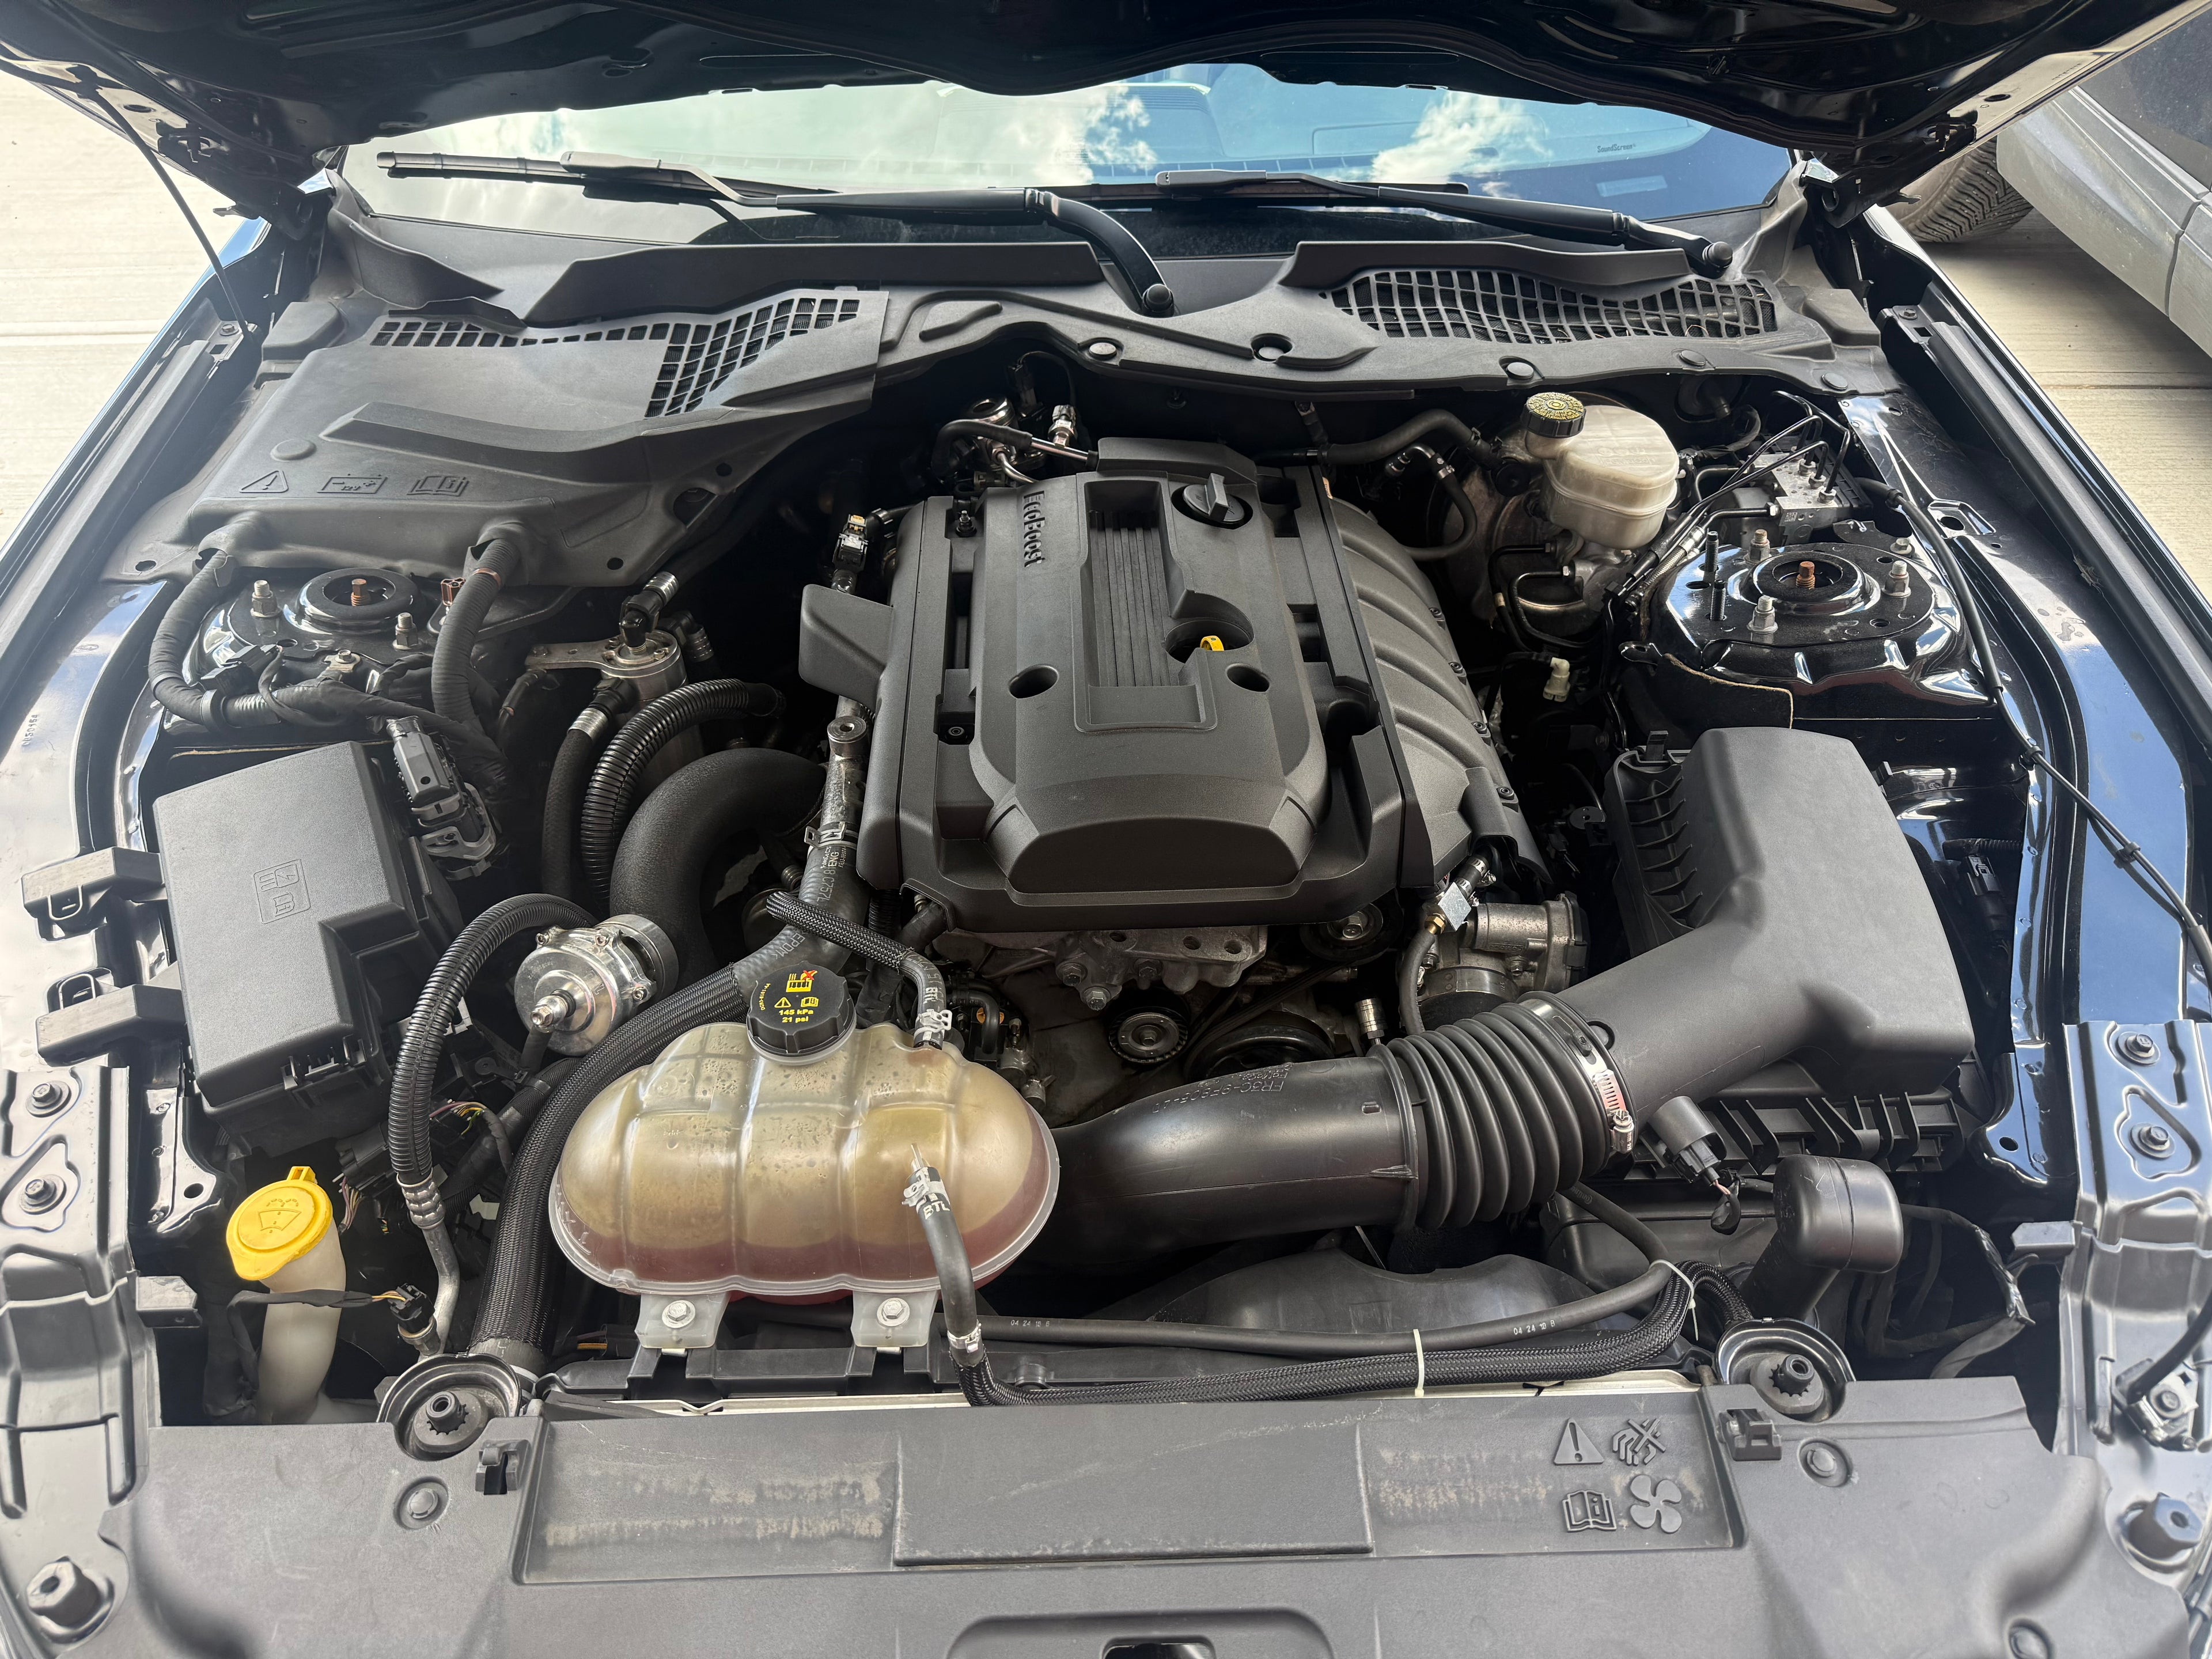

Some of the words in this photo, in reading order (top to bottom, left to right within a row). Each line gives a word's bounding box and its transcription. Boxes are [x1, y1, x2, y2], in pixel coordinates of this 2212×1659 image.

[1597, 143, 1633, 153] SoundScreen
[1023, 490, 1046, 567] EcoBoost
[828, 851, 839, 868] ENG
[795, 1016, 809, 1024] psi
[923, 1200, 950, 1219] BTL
